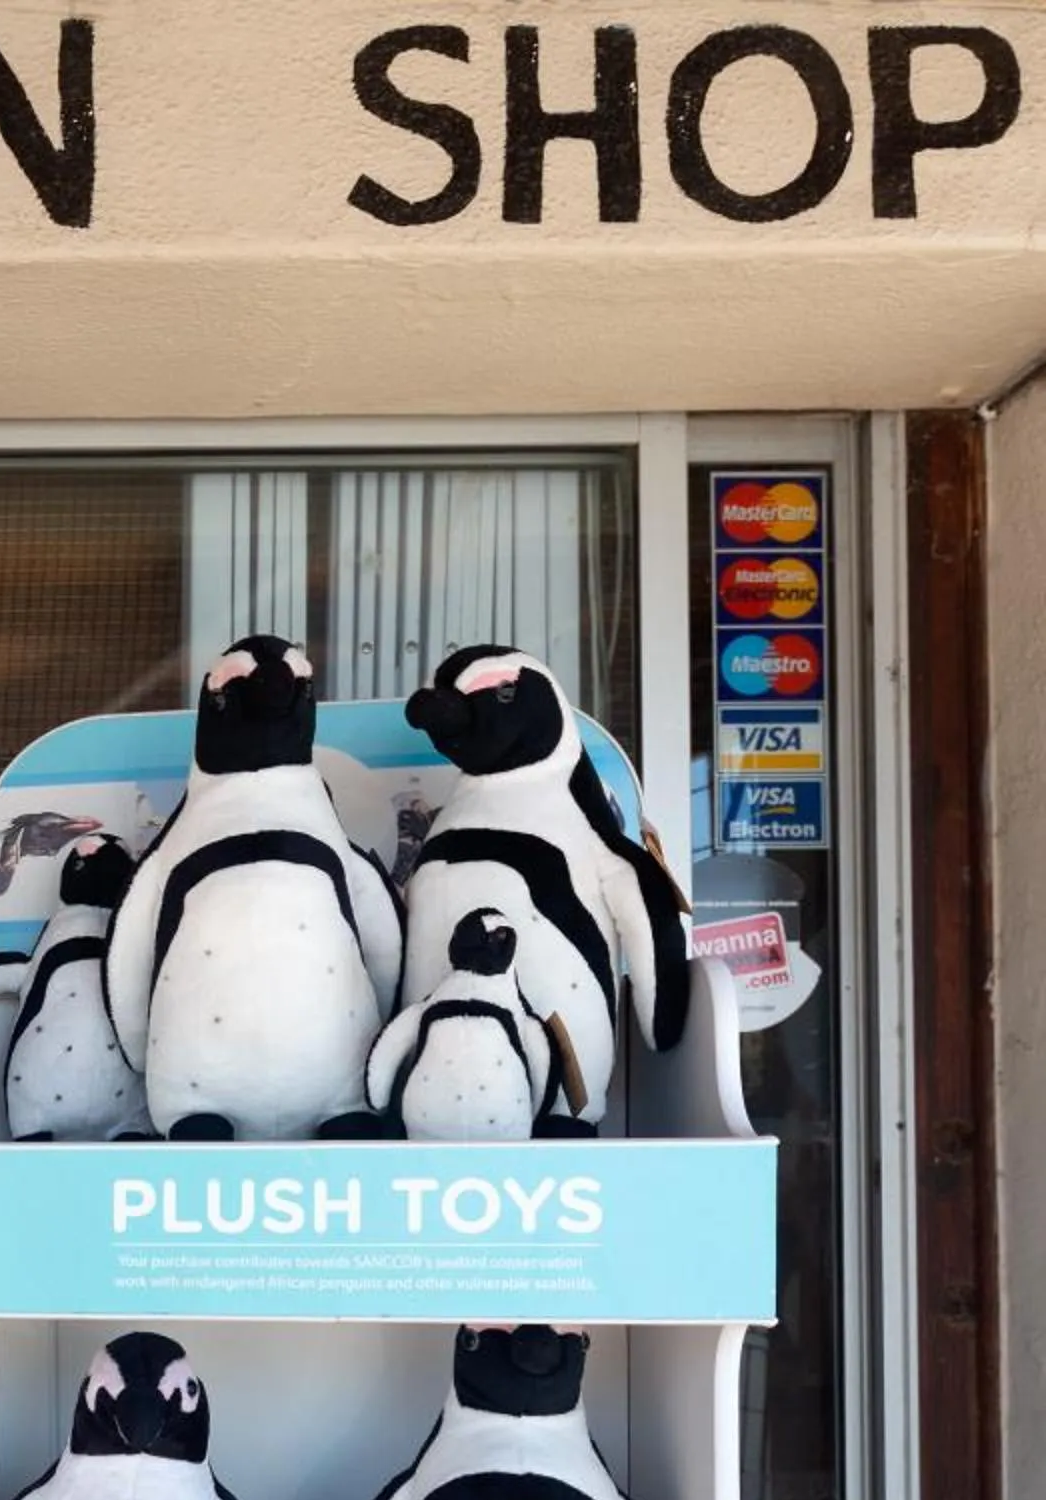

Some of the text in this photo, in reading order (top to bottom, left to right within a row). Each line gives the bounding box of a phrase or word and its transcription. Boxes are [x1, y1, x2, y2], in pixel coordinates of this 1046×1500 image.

[347, 24, 1022, 226] SHOP
[730, 655, 811, 673] Maestro
[736, 726, 803, 751] VISA
[744, 786, 796, 805] VISA
[728, 821, 816, 839] Electron
[692, 928, 779, 957] wanna
[111, 1176, 604, 1235] PLUSH TOYS
